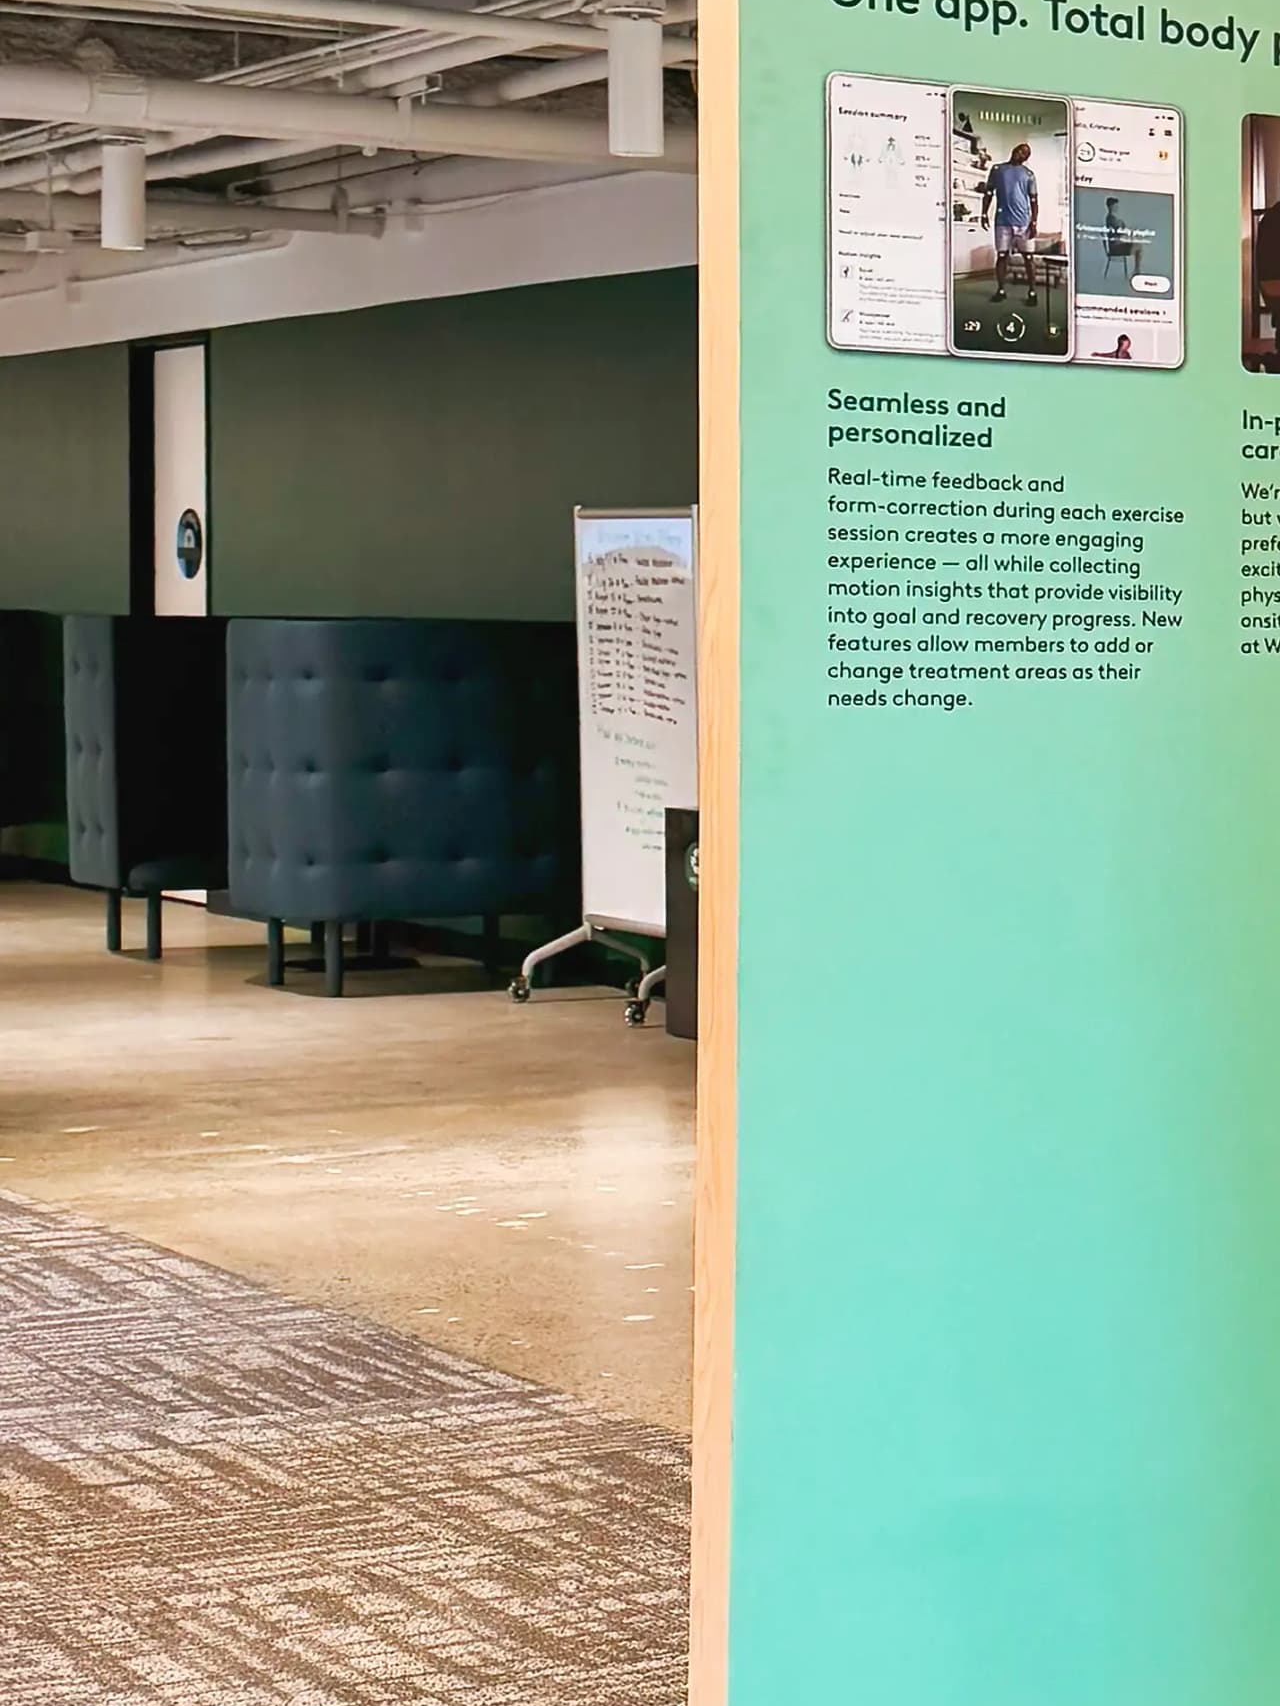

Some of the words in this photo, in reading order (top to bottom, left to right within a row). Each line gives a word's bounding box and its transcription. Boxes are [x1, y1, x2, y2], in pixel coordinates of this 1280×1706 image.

[1160, 7, 1261, 64] body
[827, 388, 950, 416] Seamless
[956, 396, 1006, 418] and
[828, 423, 993, 448] personalized
[828, 467, 927, 488] Real-time
[931, 470, 1023, 492] feedback
[1027, 475, 1065, 493] and
[827, 494, 988, 517] form-correction
[992, 500, 1055, 525] during
[1060, 503, 1106, 521] each
[1111, 508, 1185, 524] exercise
[1241, 508, 1272, 526] but
[827, 524, 899, 542] session
[904, 528, 978, 544] creates
[982, 532, 995, 545] a
[1000, 532, 1051, 547] more
[1055, 530, 1144, 554] engaging
[827, 552, 937, 574] experience
[965, 553, 989, 572] all
[993, 554, 1045, 573] while
[1049, 556, 1141, 580] collecting
[828, 580, 901, 597] motion
[906, 580, 983, 603] insights
[987, 581, 1030, 600] that
[1034, 583, 1105, 604] provide
[1108, 583, 1183, 606] visibility
[828, 607, 868, 624] into
[872, 606, 917, 630] goal
[922, 607, 960, 625] and
[965, 612, 1048, 631] recovery
[1052, 614, 1136, 632] progress.
[1142, 610, 1183, 627] New
[827, 633, 912, 652] features
[916, 634, 969, 652] allow
[974, 635, 1065, 653] members
[1069, 637, 1089, 653] to
[1093, 636, 1130, 654] add
[1134, 641, 1154, 654] or
[1240, 639, 1261, 654] at
[827, 660, 904, 685] change
[908, 663, 1010, 680] treatment
[1014, 667, 1068, 680] areas
[1072, 667, 1094, 680] as
[1097, 662, 1142, 680] their
[828, 688, 888, 707] needs
[892, 688, 973, 712] change.
